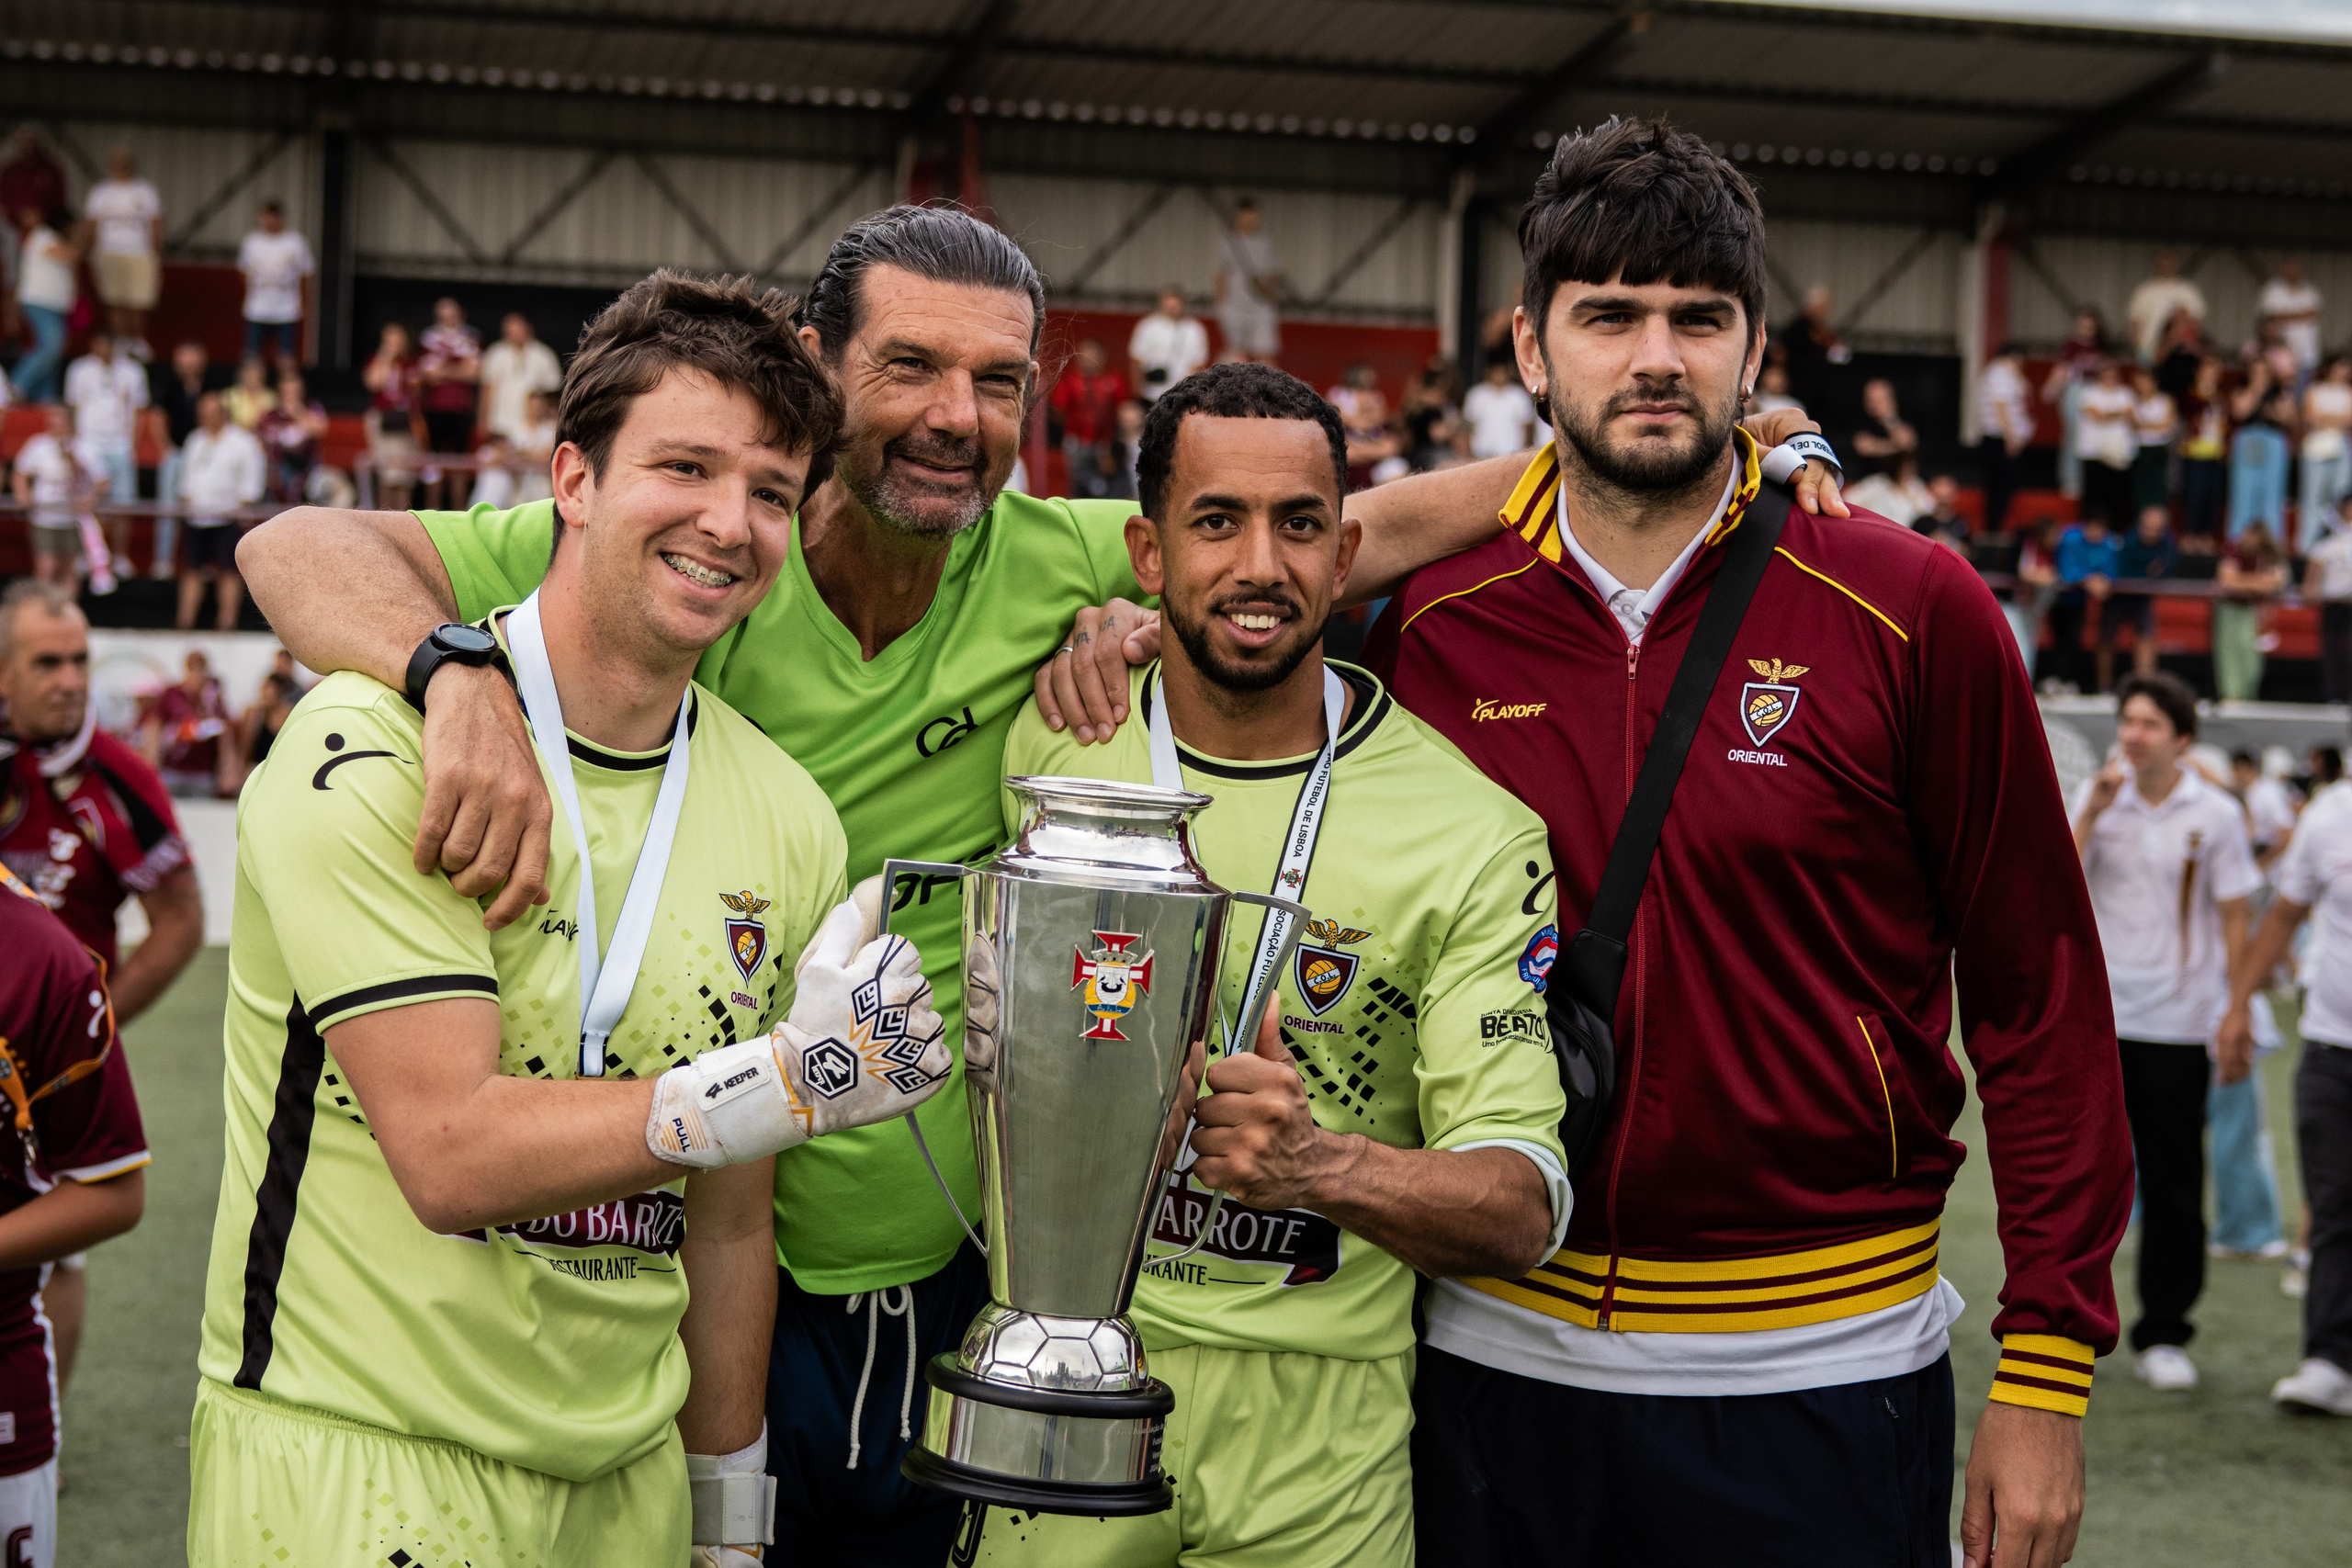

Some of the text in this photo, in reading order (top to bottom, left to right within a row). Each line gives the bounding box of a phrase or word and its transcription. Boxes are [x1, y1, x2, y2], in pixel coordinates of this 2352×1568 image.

[1797, 441, 1810, 450] DE
[1478, 704, 1547, 723] PLAYOFF
[1728, 749, 1788, 766] ORIENTAL
[1306, 770, 1329, 808] FUTEBOL
[1302, 809, 1314, 822] DE
[1293, 824, 1309, 858] LISBOA
[1266, 909, 1286, 958] SOCIAÇÃO
[1313, 972, 1336, 985] C.O.L.
[1283, 1014, 1345, 1034] ORIENTAL
[723, 1066, 759, 1089] KEEPER
[673, 1117, 691, 1153] PULL
[1157, 1195, 1306, 1256] ARROTE
